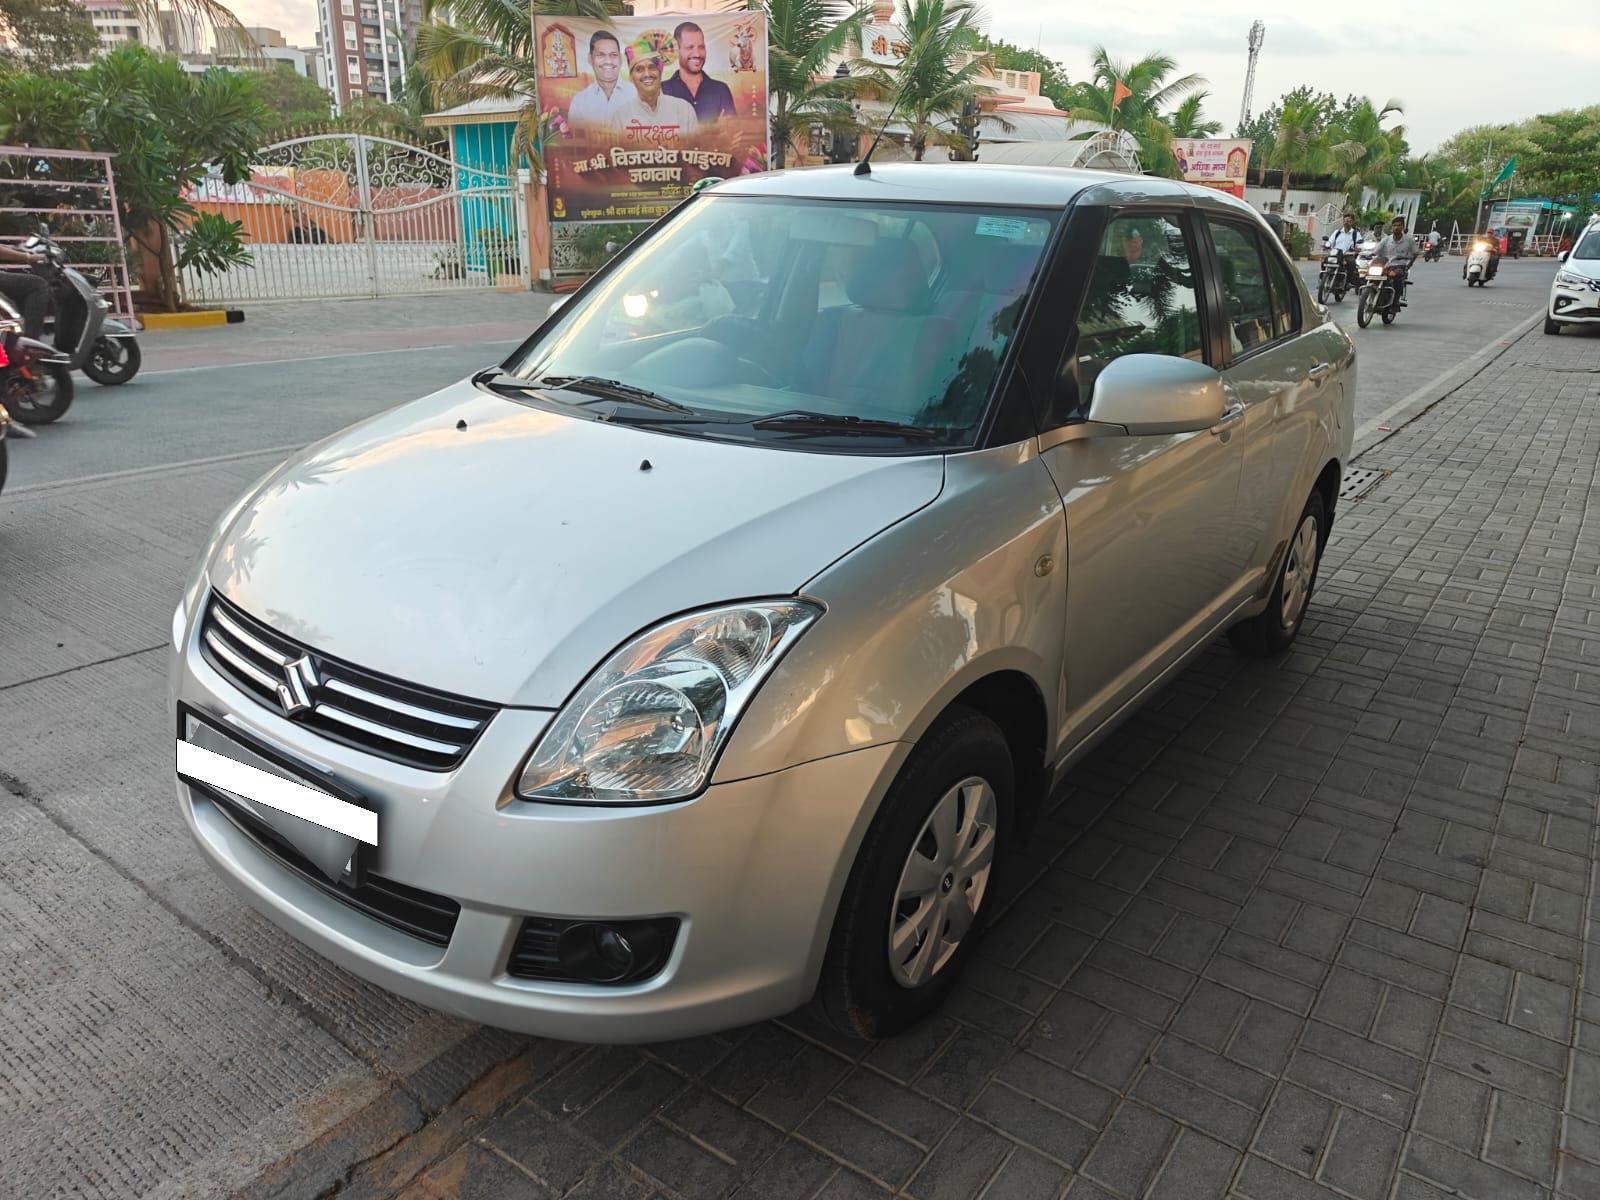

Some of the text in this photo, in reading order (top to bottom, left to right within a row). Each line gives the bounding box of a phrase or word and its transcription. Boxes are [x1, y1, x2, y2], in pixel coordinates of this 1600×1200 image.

[626, 118, 681, 144] गोरक्षक
[681, 147, 733, 170] पांडुरंग
[629, 167, 682, 184] जगताप
